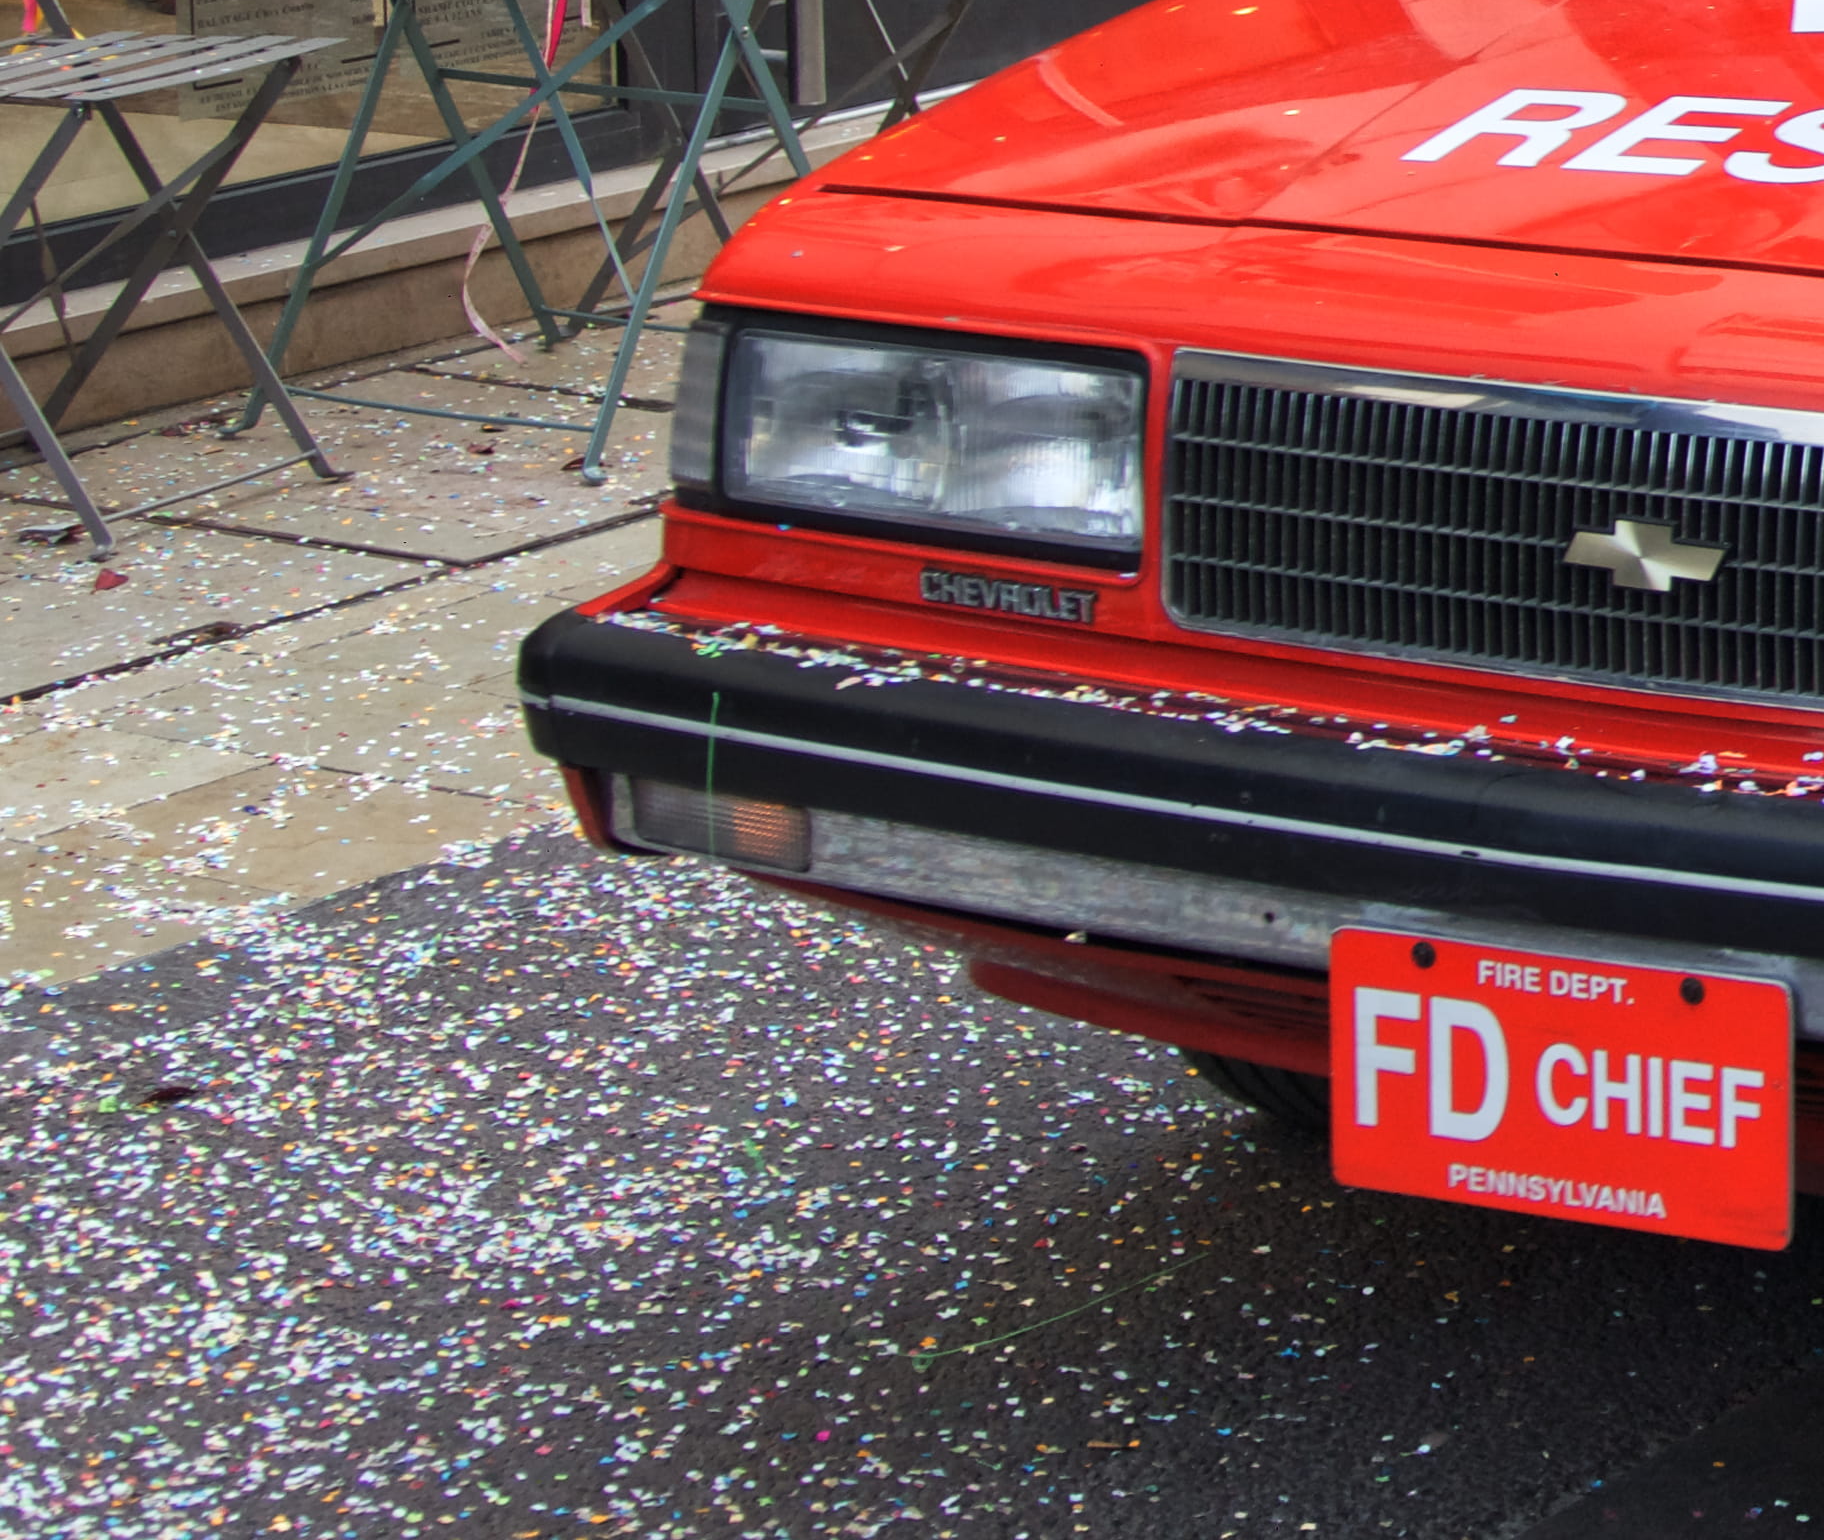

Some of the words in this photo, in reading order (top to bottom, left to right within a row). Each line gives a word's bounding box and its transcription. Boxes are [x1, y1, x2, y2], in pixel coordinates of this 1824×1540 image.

[918, 567, 1097, 625] CHEVROLET
[1477, 960, 1542, 994] FIRE
[1548, 969, 1636, 1005] DEPT.
[1353, 986, 1510, 1142] FD
[1534, 1043, 1765, 1149] CHIEF
[1447, 1163, 1667, 1220] PENNSYLVANIA
